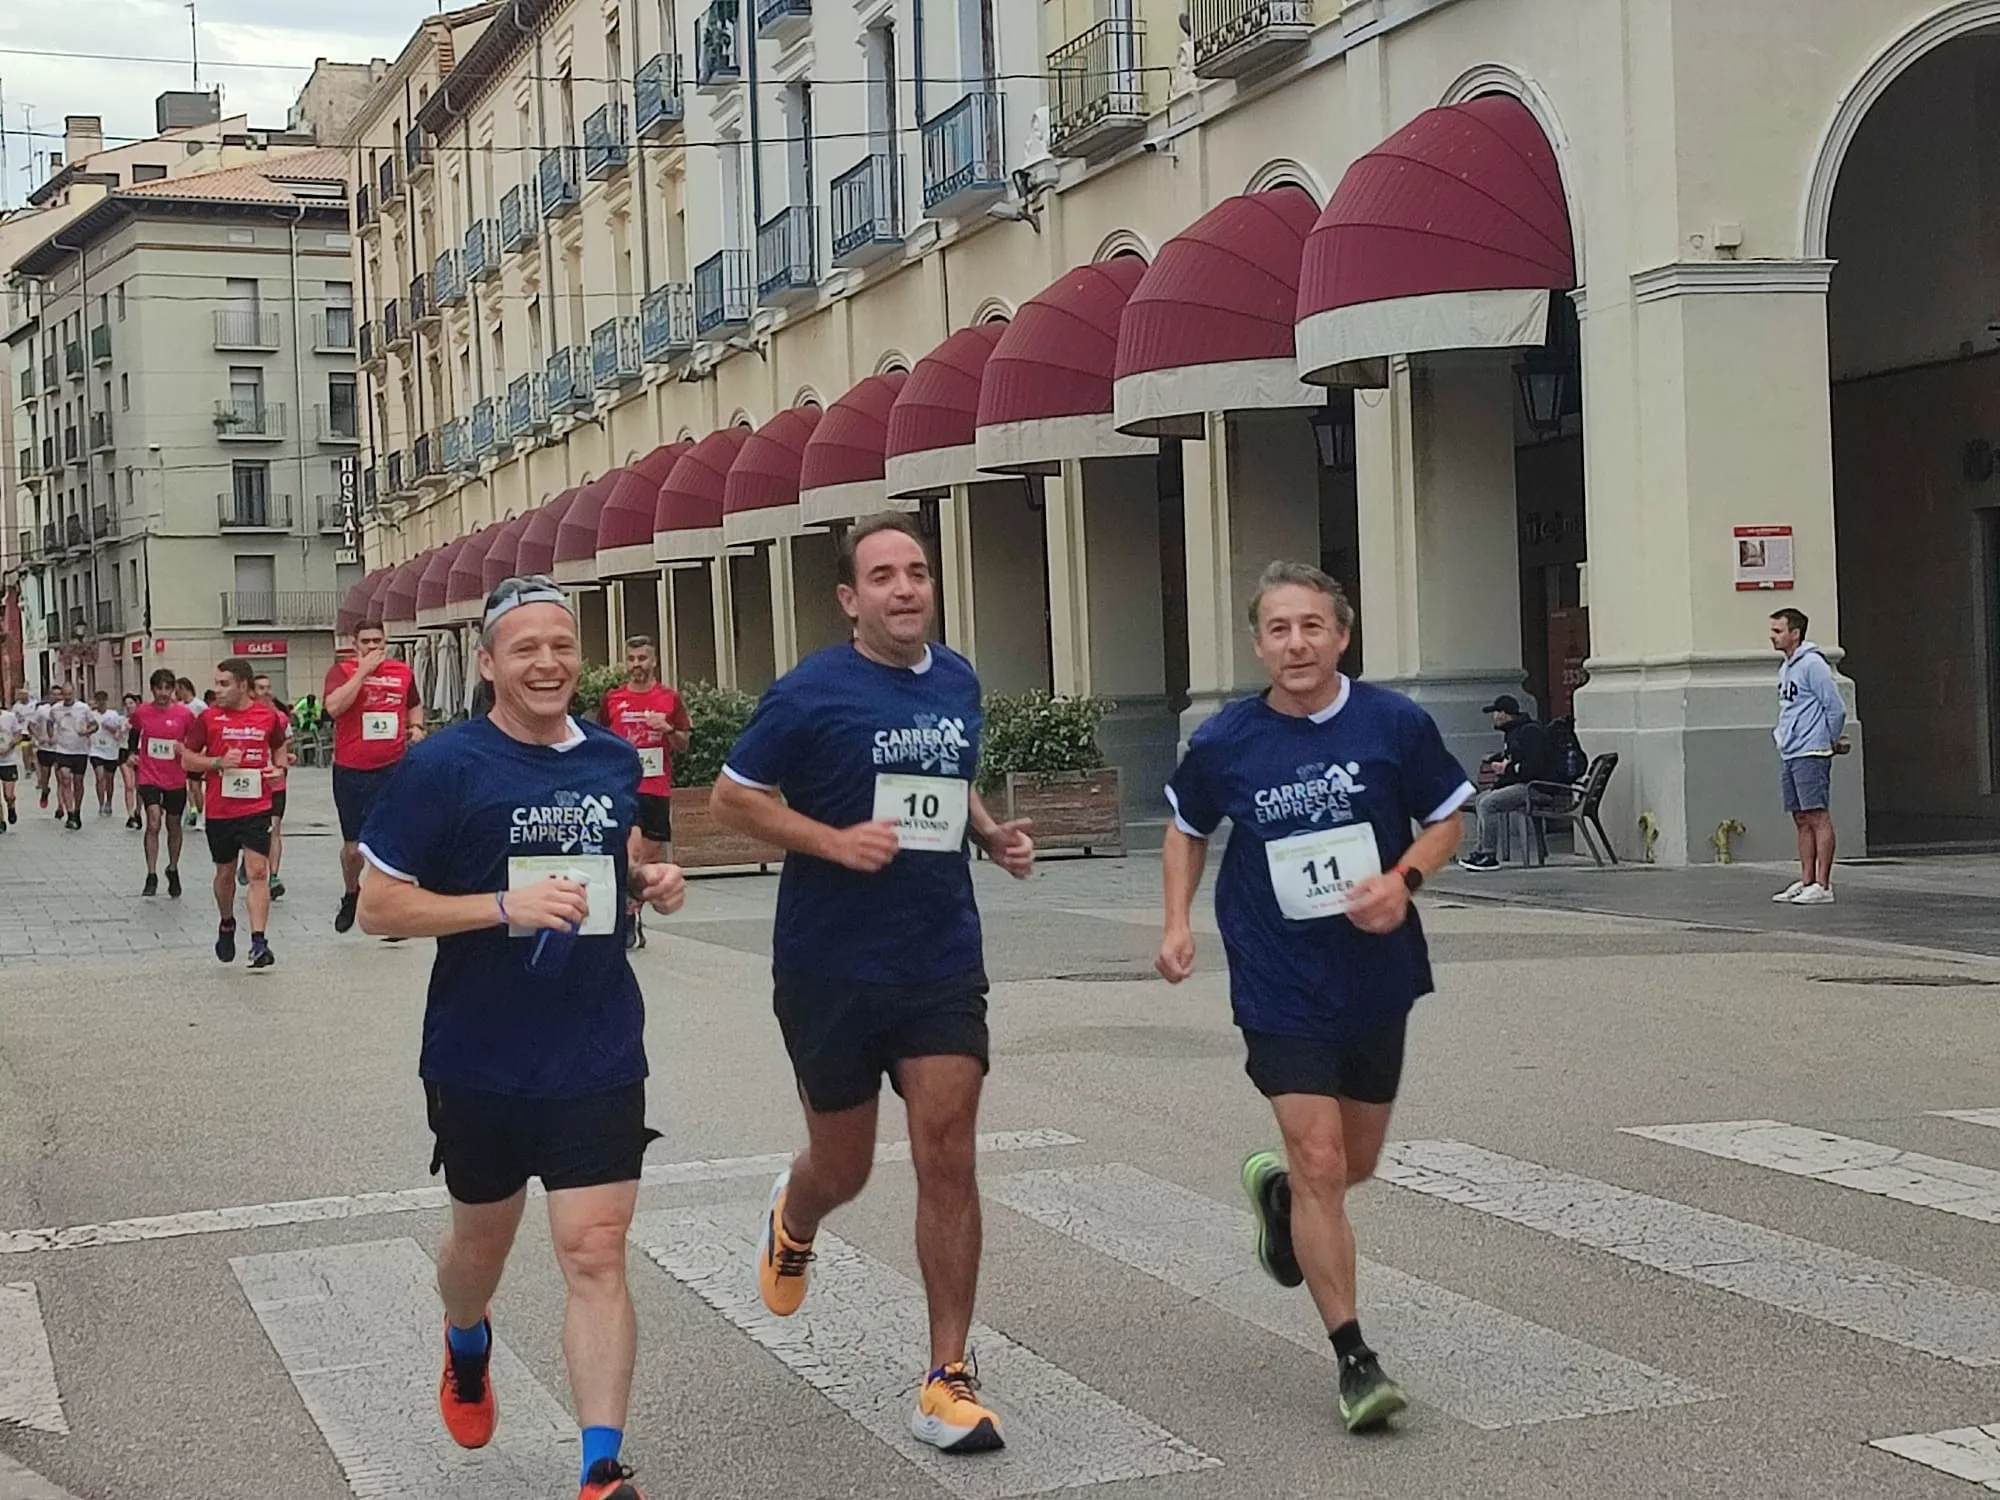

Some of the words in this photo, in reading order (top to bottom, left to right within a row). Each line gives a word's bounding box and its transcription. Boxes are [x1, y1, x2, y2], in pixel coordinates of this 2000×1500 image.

[341, 457, 356, 547] HOSTAL
[874, 728, 956, 748] CARRERA
[872, 743, 960, 764] EMPRESAS
[904, 793, 939, 818] 10
[1254, 779, 1348, 807] CARRERA
[512, 806, 601, 826] CARRERA
[1255, 792, 1351, 823] EMPRESAS
[509, 824, 604, 844] EMPRESAS
[1302, 856, 1340, 885] 11
